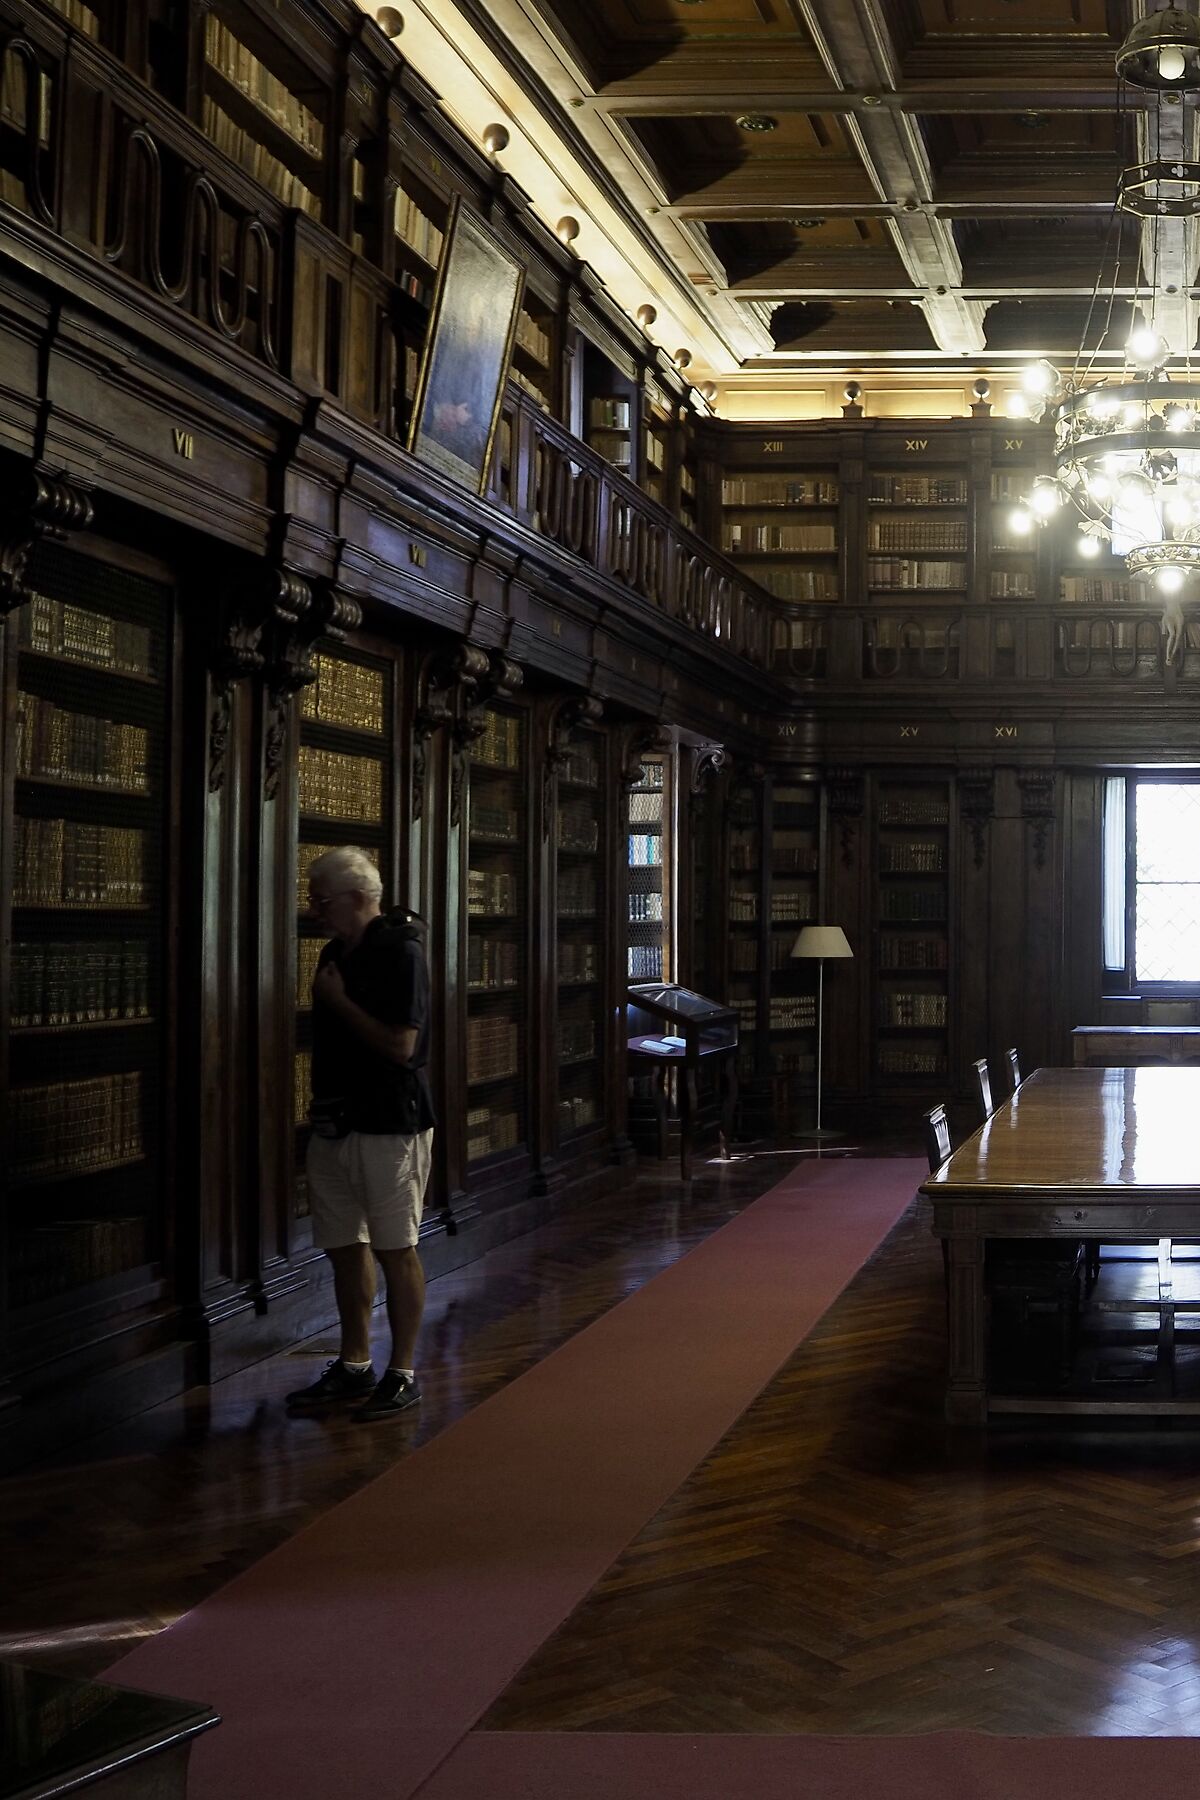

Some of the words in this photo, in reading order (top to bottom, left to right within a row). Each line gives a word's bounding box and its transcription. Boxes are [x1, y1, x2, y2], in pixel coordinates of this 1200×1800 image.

[172, 428, 193, 460] VII
[762, 441, 783, 452] XIII
[905, 440, 928, 451] XIV
[1005, 440, 1023, 450] XV
[778, 725, 797, 736] XIV
[900, 726, 919, 737] XV
[995, 727, 1017, 737] XVI
